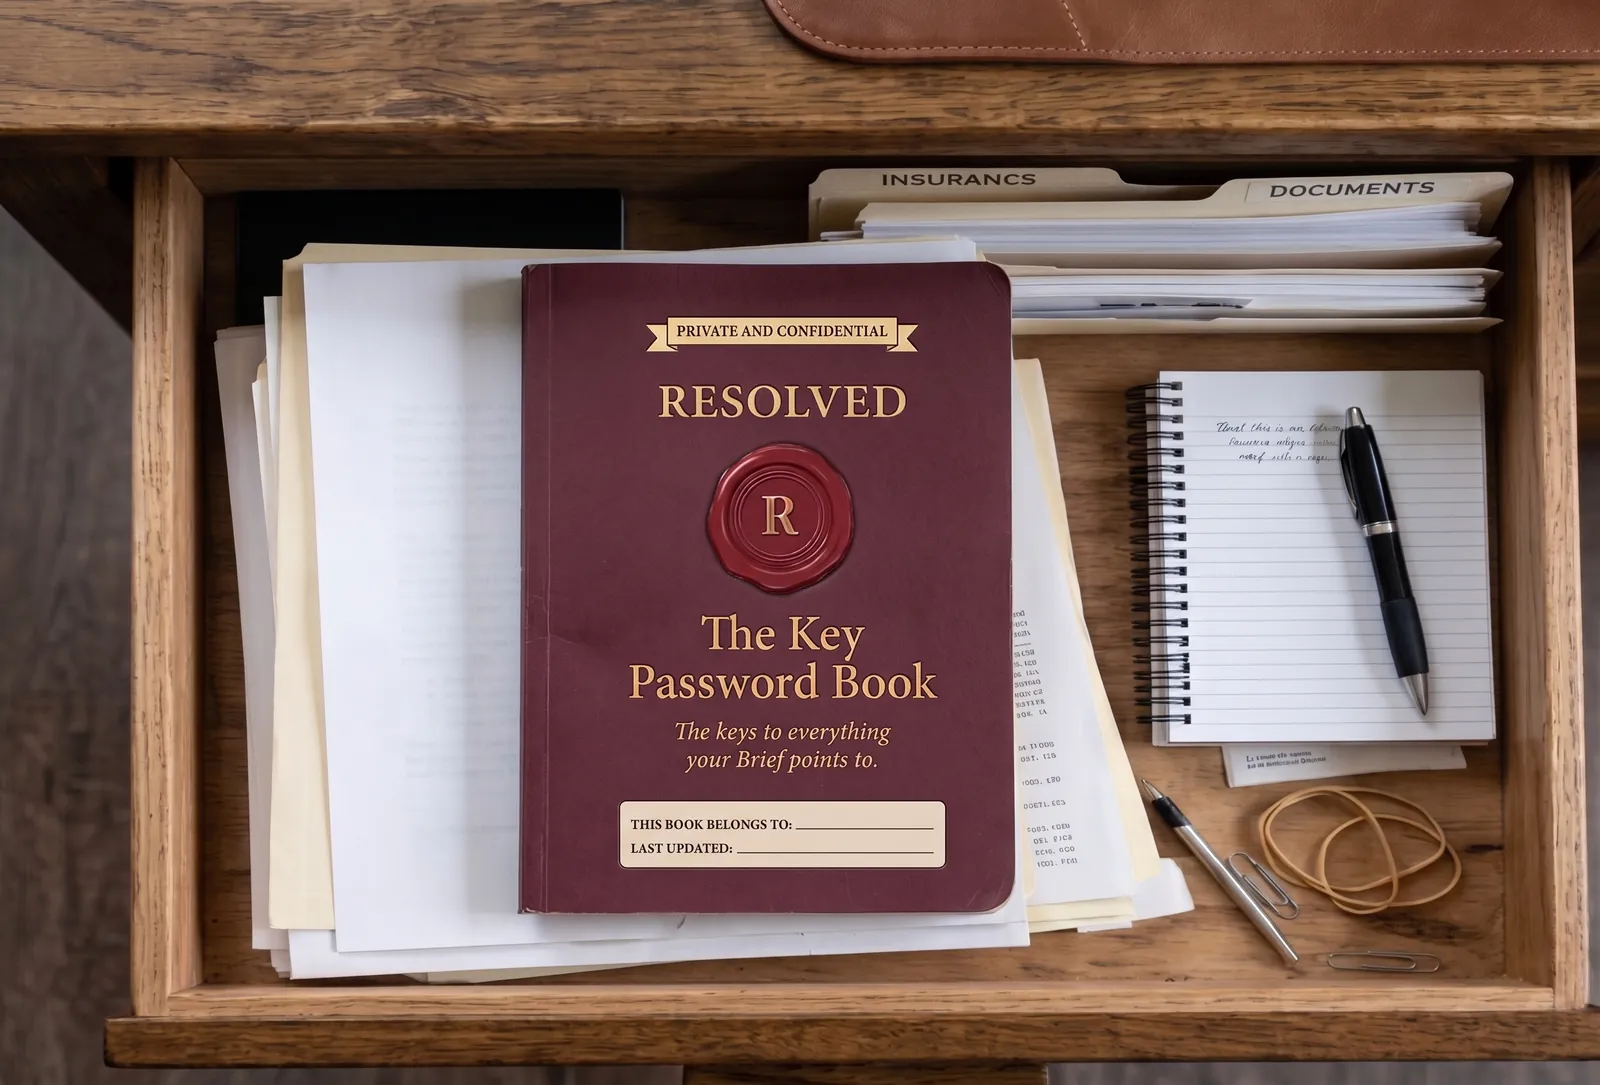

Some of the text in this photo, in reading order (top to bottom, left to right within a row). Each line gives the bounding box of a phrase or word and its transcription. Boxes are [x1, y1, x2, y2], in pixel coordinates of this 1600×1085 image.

[882, 173, 1036, 186] INSURANCS
[1270, 182, 1435, 198] DOCUMENTS
[676, 325, 888, 337] PRIVATE AND CONFIDENTIAL
[658, 385, 907, 418] RESOLVED
[761, 495, 799, 535] R
[701, 613, 865, 661] The Key
[629, 661, 938, 699] Password Book
[675, 721, 891, 746] The keys to everything
[685, 749, 878, 773] your Brief points to.
[631, 819, 792, 830] THIS BOOK BELONGS TO:
[631, 843, 733, 854] LAST UPDATED:
